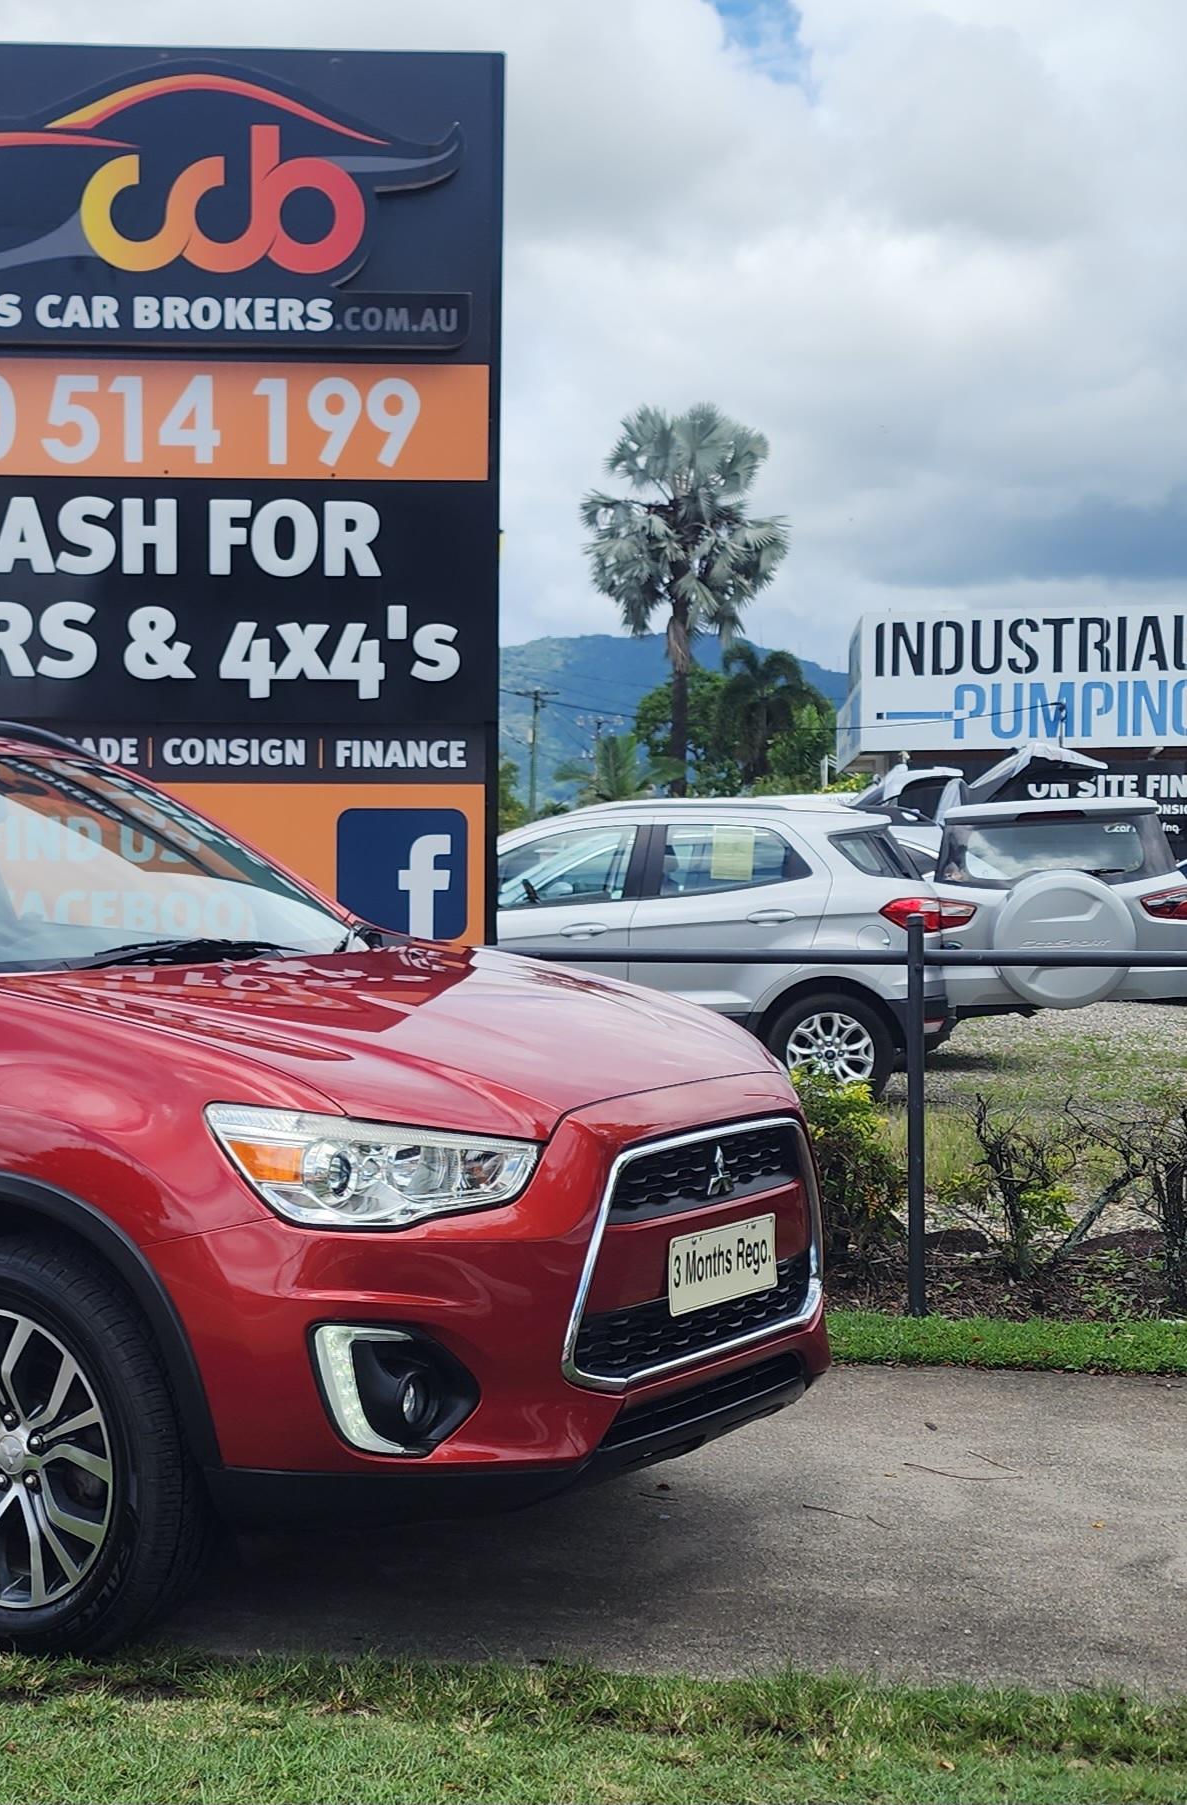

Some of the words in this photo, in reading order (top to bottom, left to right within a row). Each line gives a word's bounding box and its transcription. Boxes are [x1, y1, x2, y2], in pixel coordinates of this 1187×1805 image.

[34, 293, 121, 330] CAR
[40, 373, 221, 465] 514
[252, 376, 421, 469] 199
[208, 498, 382, 578] FOR
[123, 605, 196, 682] &
[162, 737, 307, 767] CONSIGN
[335, 739, 468, 769] FINANCE
[1077, 774, 1140, 798] SITE
[673, 1255, 681, 1288] 3
[685, 1243, 733, 1286] Months
[736, 1237, 772, 1276] Rego.
